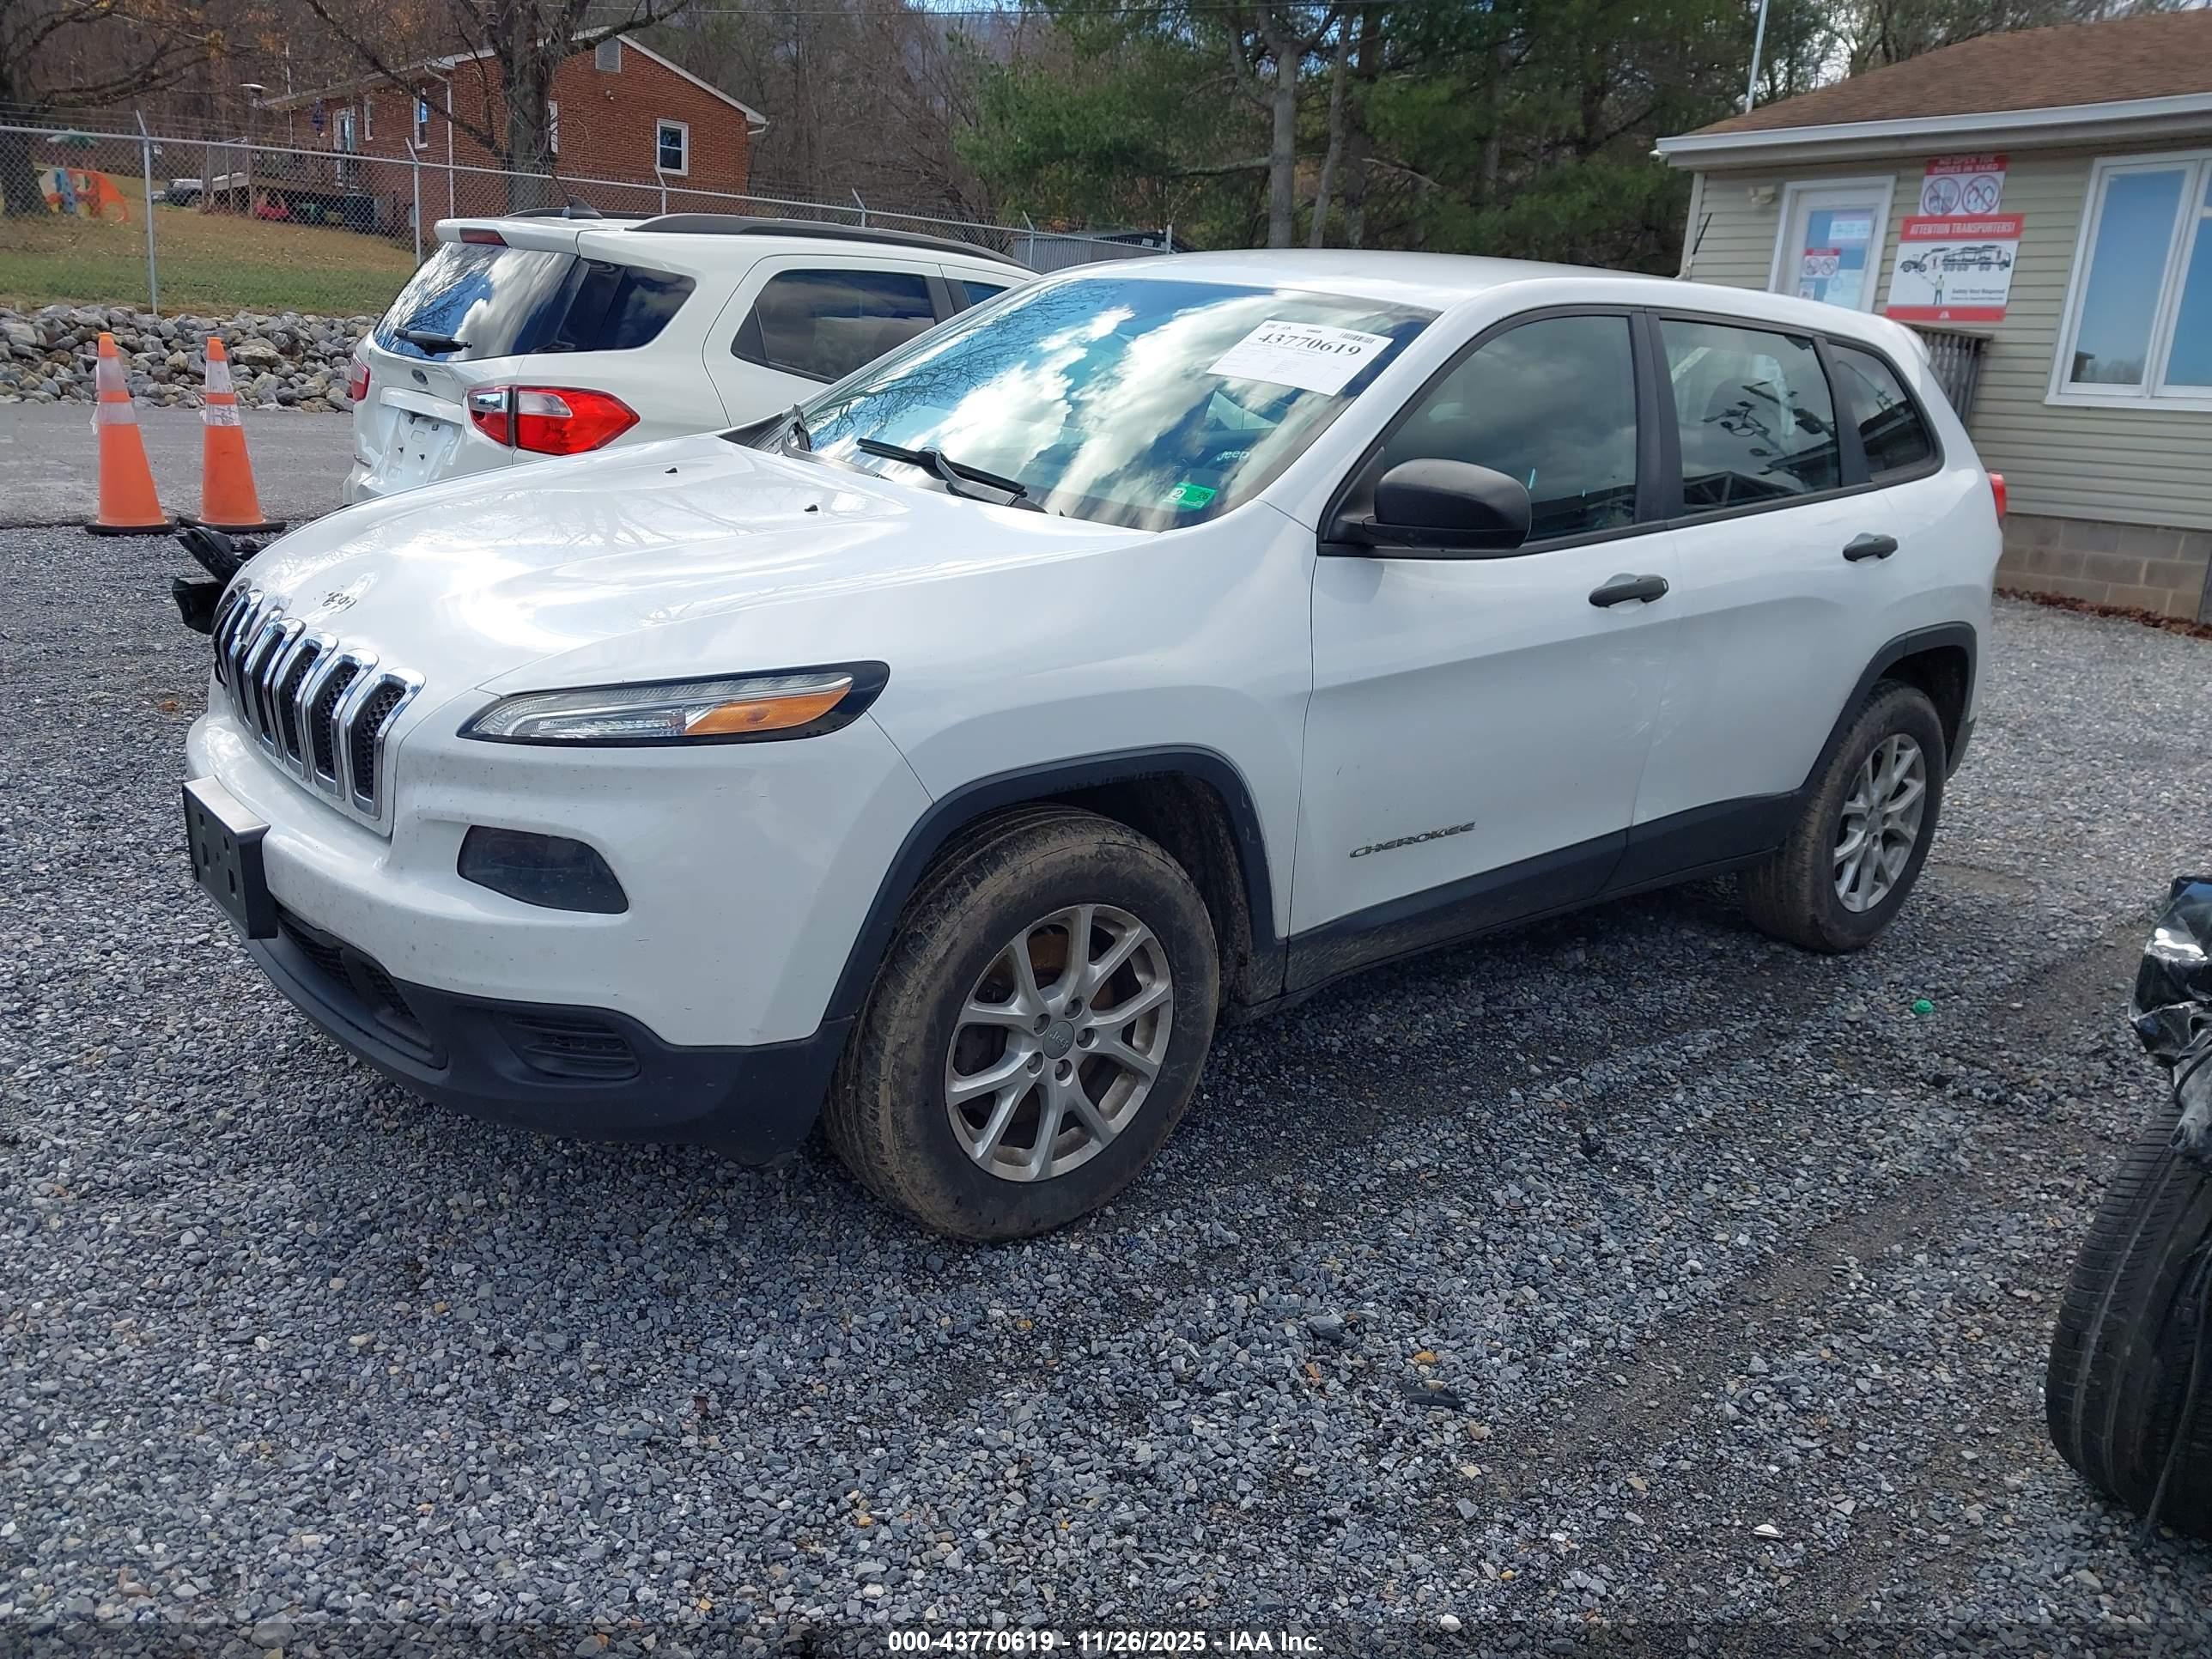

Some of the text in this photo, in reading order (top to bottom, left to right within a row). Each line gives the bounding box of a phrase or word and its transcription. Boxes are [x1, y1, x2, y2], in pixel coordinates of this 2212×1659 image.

[1909, 221, 2016, 235] ATTENTION TRANSPORTERS!
[1258, 331, 1362, 356] 43770619
[1216, 450, 1250, 461] Jeep
[1173, 489, 1183, 499] 2
[1349, 821, 1476, 859] CHEROKEE
[1048, 1030, 1070, 1049] Jeep
